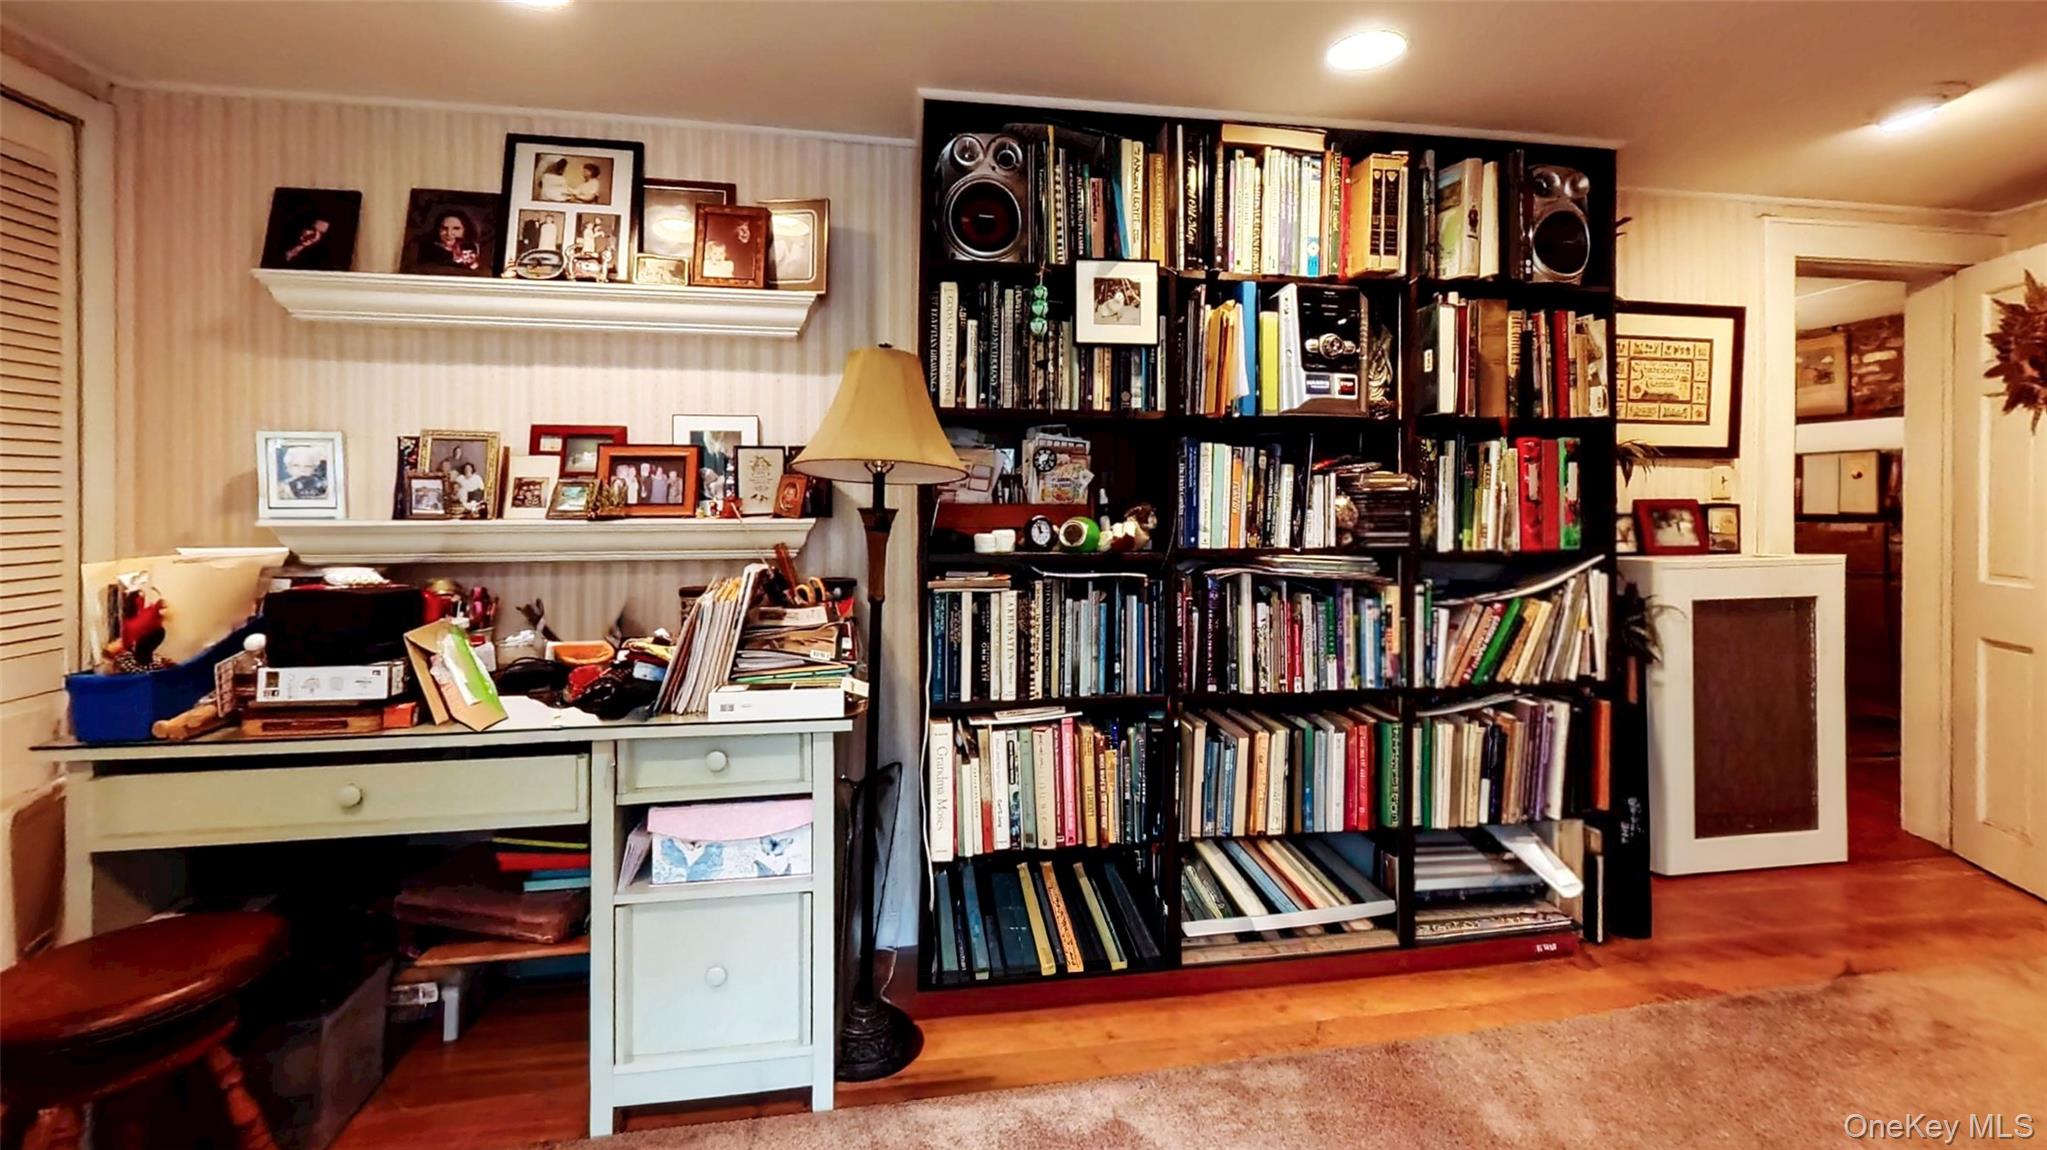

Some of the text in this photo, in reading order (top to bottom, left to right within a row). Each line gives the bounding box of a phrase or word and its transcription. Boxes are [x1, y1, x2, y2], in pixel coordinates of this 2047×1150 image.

[1185, 217, 1197, 245] Maps
[991, 308, 999, 336] WORLD
[930, 349, 938, 392] DRAWINGS
[990, 338, 998, 386] MYTHOLOGY
[1007, 602, 1015, 660] AKHENATEN
[936, 746, 949, 832] Grandma Moses
